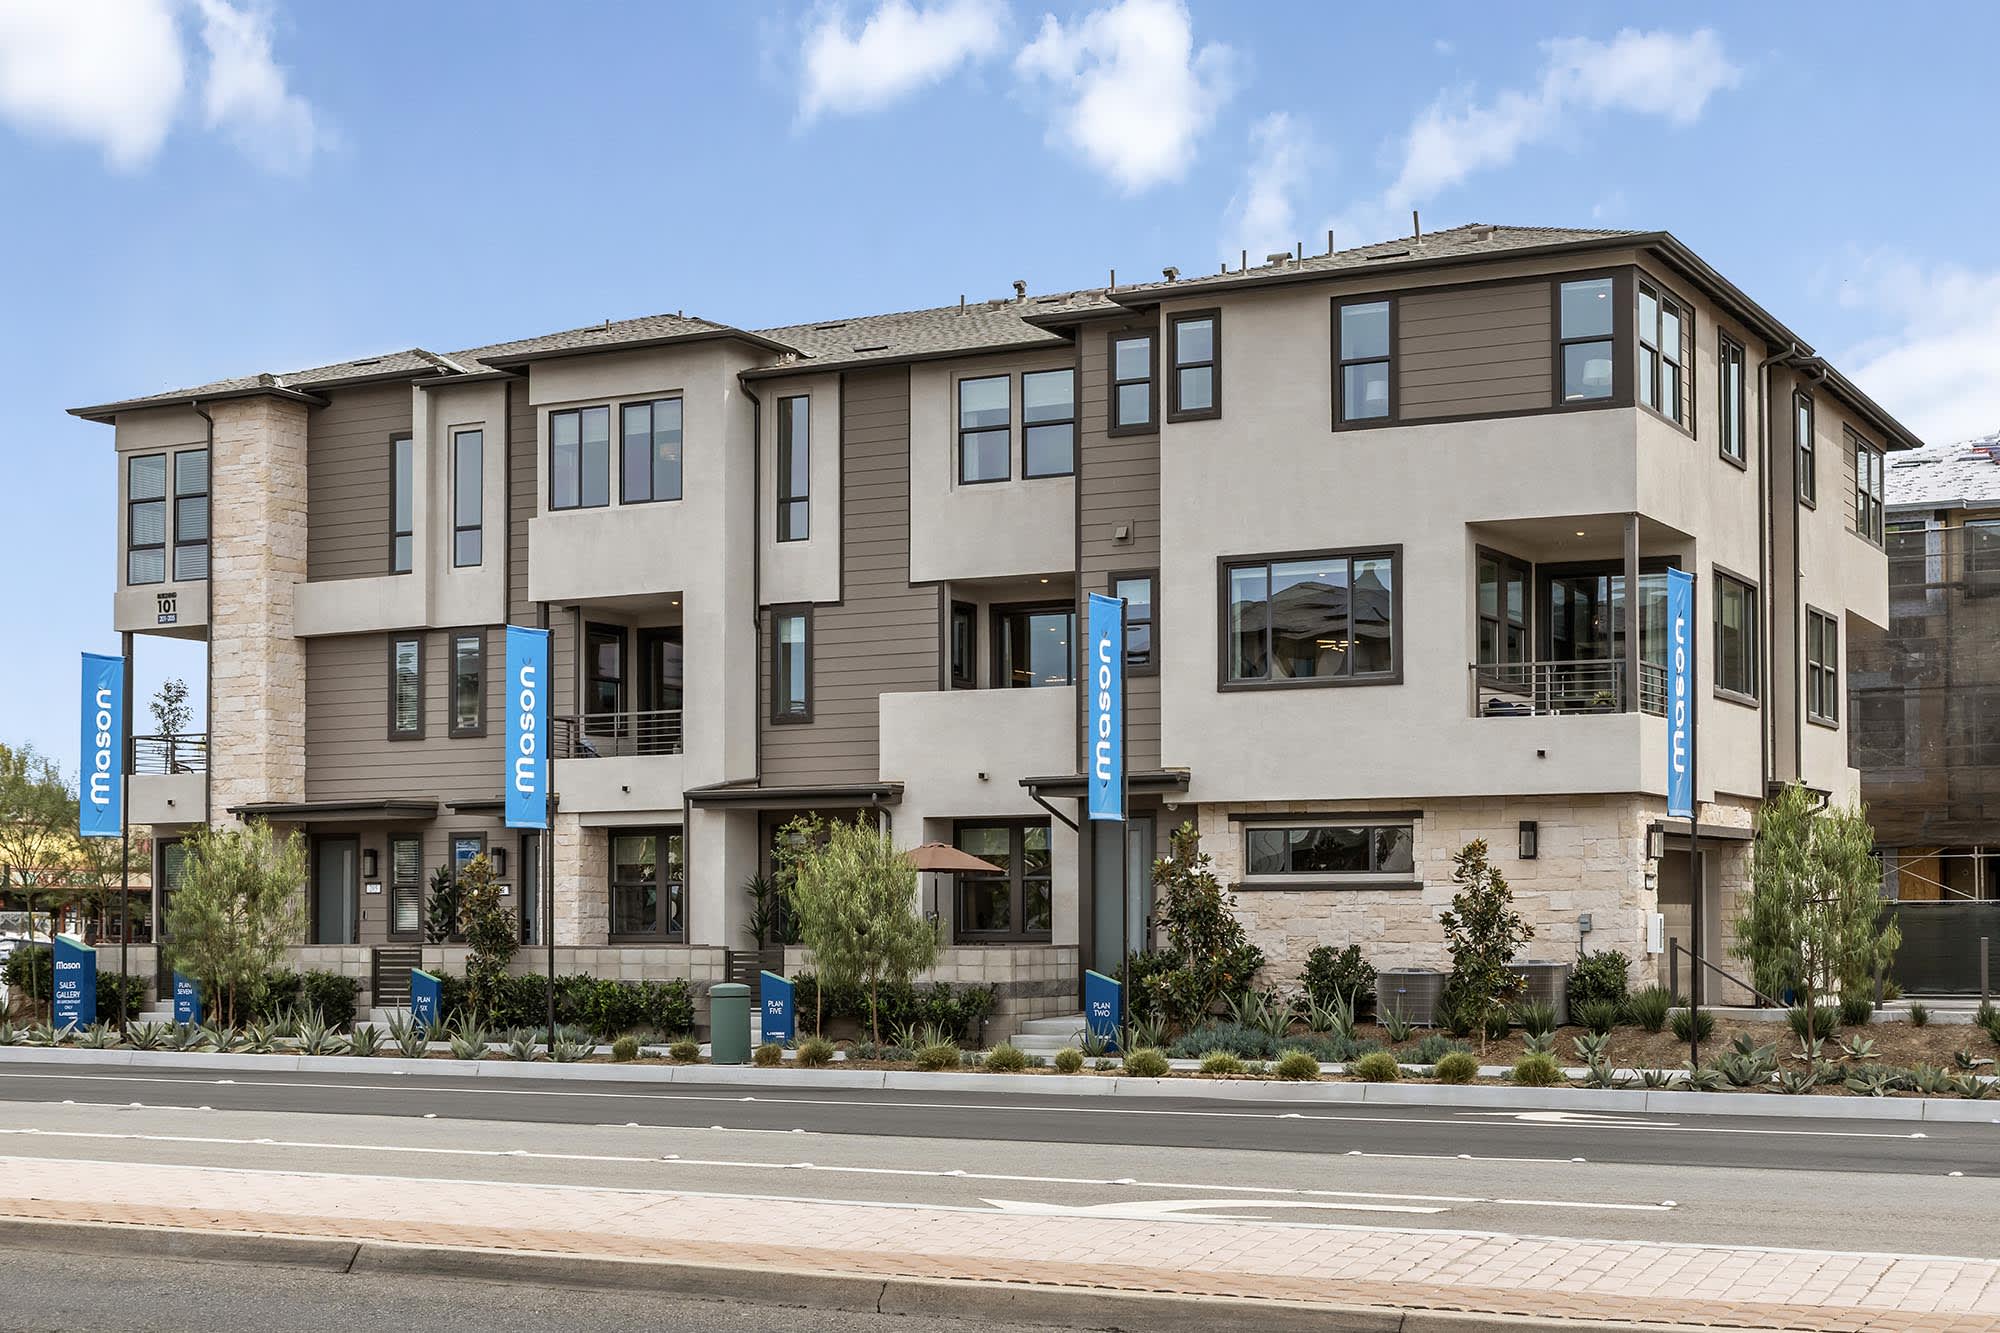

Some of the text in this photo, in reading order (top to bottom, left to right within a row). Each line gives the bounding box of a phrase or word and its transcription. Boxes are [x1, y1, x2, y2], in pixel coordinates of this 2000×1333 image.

[157, 600, 176, 613] 101
[59, 981, 76, 989] SALES
[56, 991, 81, 999] GALLERY
[1093, 1001, 1111, 1009] PLAN
[769, 1007, 783, 1015] FIVE
